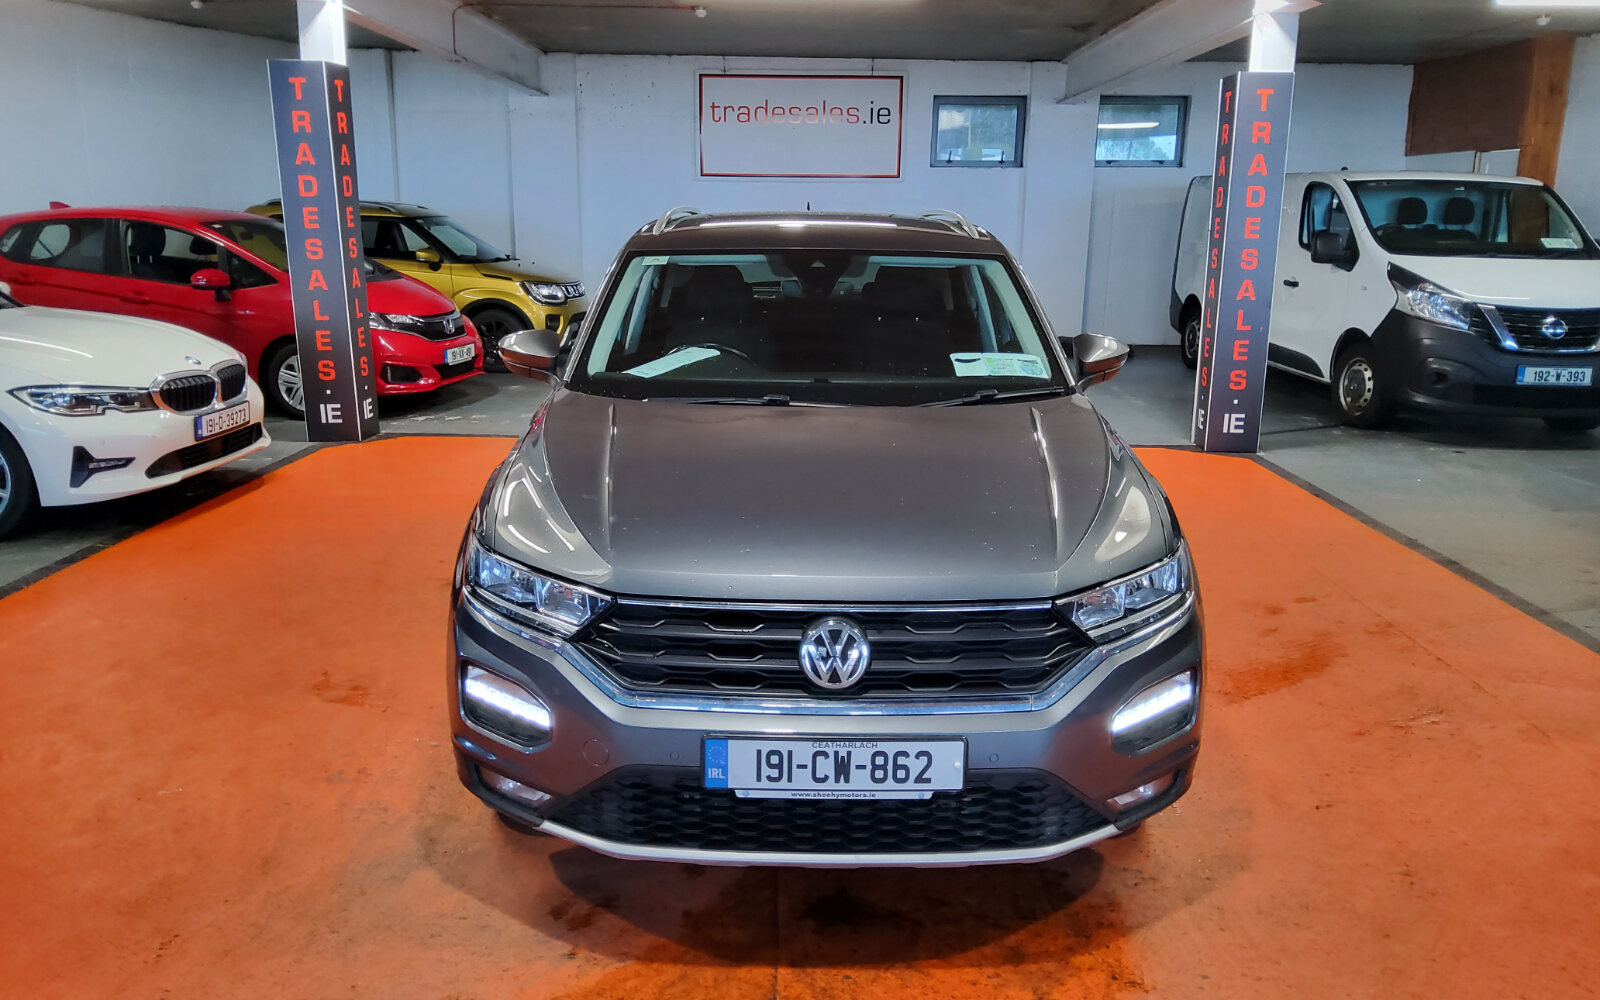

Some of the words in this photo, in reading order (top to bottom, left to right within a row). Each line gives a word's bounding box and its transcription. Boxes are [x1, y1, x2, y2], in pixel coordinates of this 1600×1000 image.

[709, 99, 891, 125] tradesales.ie
[1533, 370, 1586, 383] 192-W-393
[206, 408, 247, 434] 191-D-39273
[811, 741, 878, 749] CEATHARLACH
[707, 767, 726, 780] IRL
[755, 749, 933, 784] 191-CW-862
